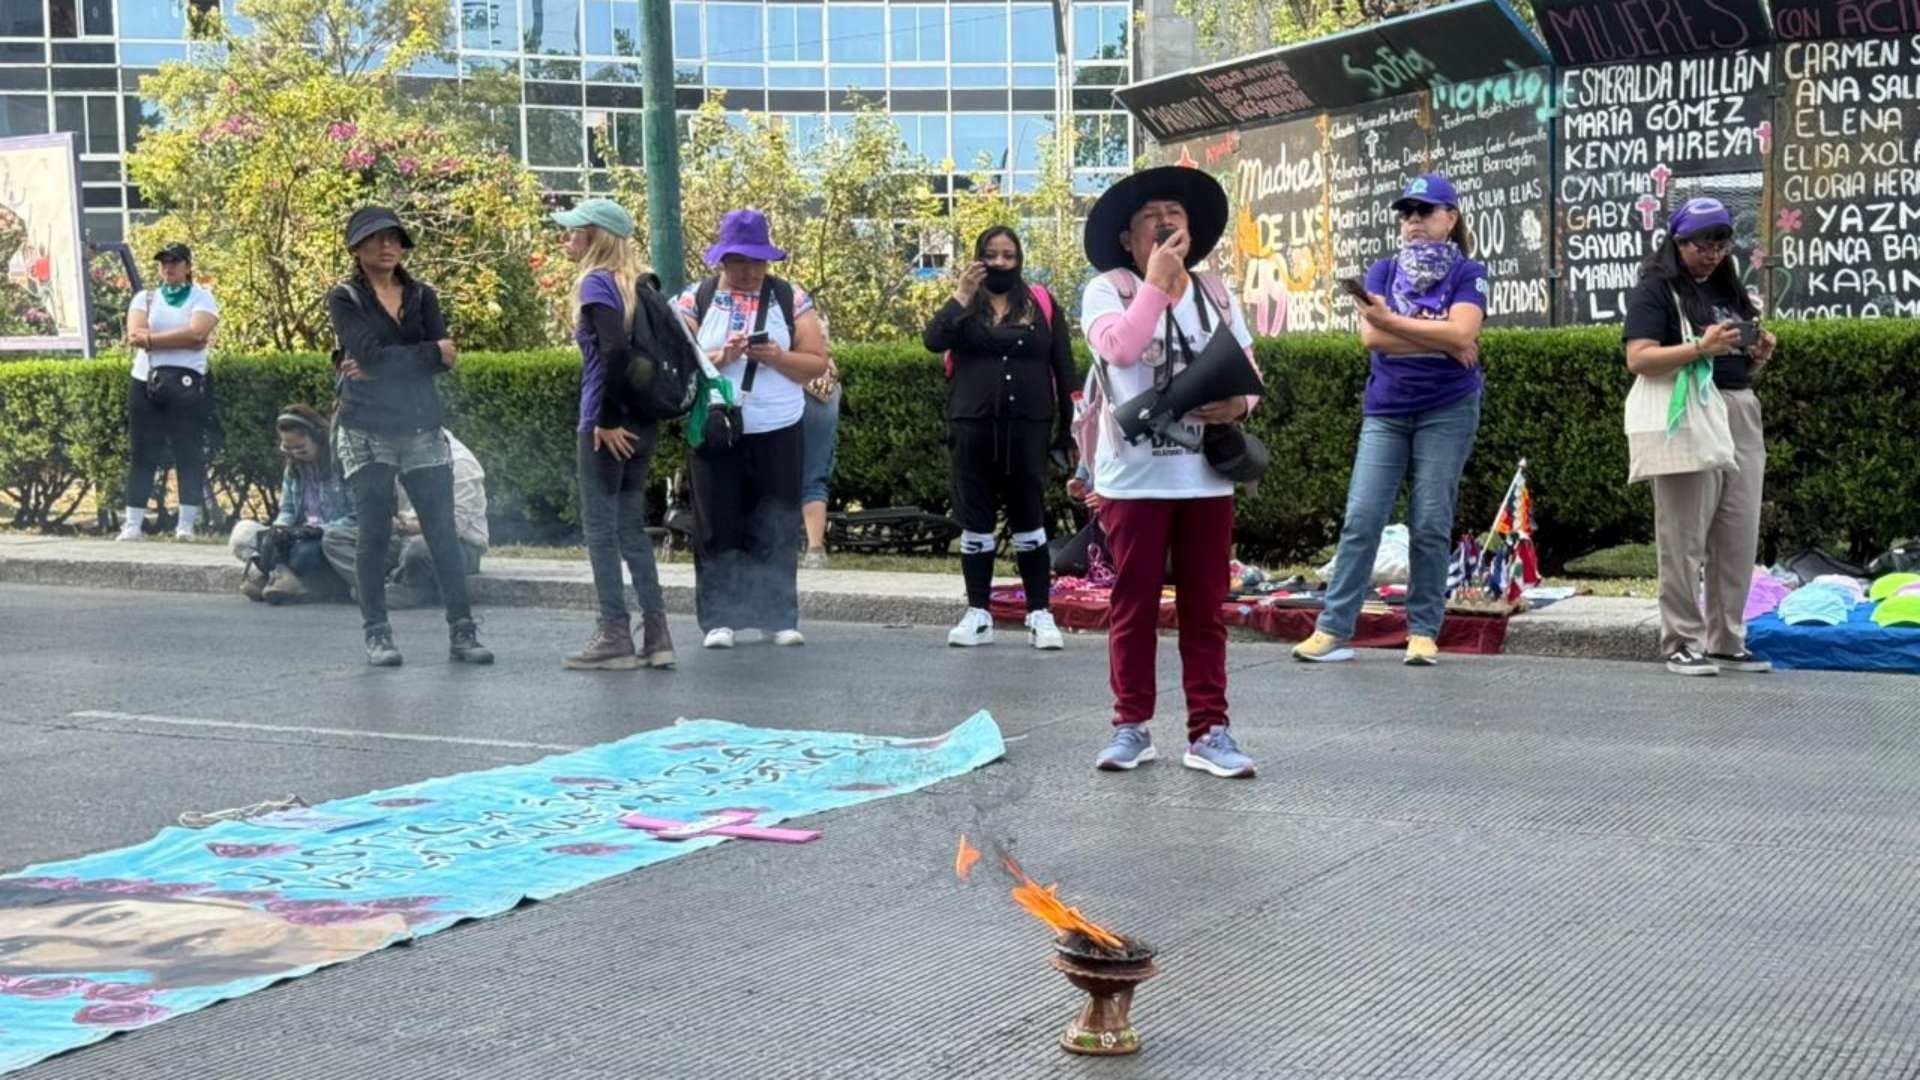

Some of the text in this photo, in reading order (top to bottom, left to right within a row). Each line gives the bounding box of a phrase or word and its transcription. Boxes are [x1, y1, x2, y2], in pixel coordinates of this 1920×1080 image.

[1548, 0, 1749, 62] MUJERES
[1776, 0, 1920, 38] CON ÁCI
[1784, 40, 1900, 79] CARMEN
[1562, 49, 1771, 109] ESMERALDA MILLÁN
[1796, 74, 1920, 107] ANA SAL
[1564, 106, 1633, 140] MARÍA
[1646, 96, 1746, 132] GÓMEZ
[1796, 107, 1903, 138] ELENA
[1482, 149, 1537, 176] Barragán
[1565, 127, 1752, 170] KENYA MIREYA
[1784, 143, 1850, 171] ELISA
[1237, 142, 1326, 205] Madres
[1561, 174, 1652, 203] CYNTHIA
[1784, 171, 1866, 202] GLORIA
[1477, 188, 1507, 210] SILVA
[1510, 178, 1543, 205] ELIAS
[1257, 205, 1325, 256] DE LXS
[1566, 200, 1632, 231] GABY
[1333, 231, 1381, 257] Romero
[1567, 230, 1643, 260] SAYURI
[1782, 233, 1920, 269] BIANCA BA
[1486, 277, 1549, 316] LAZADAS
